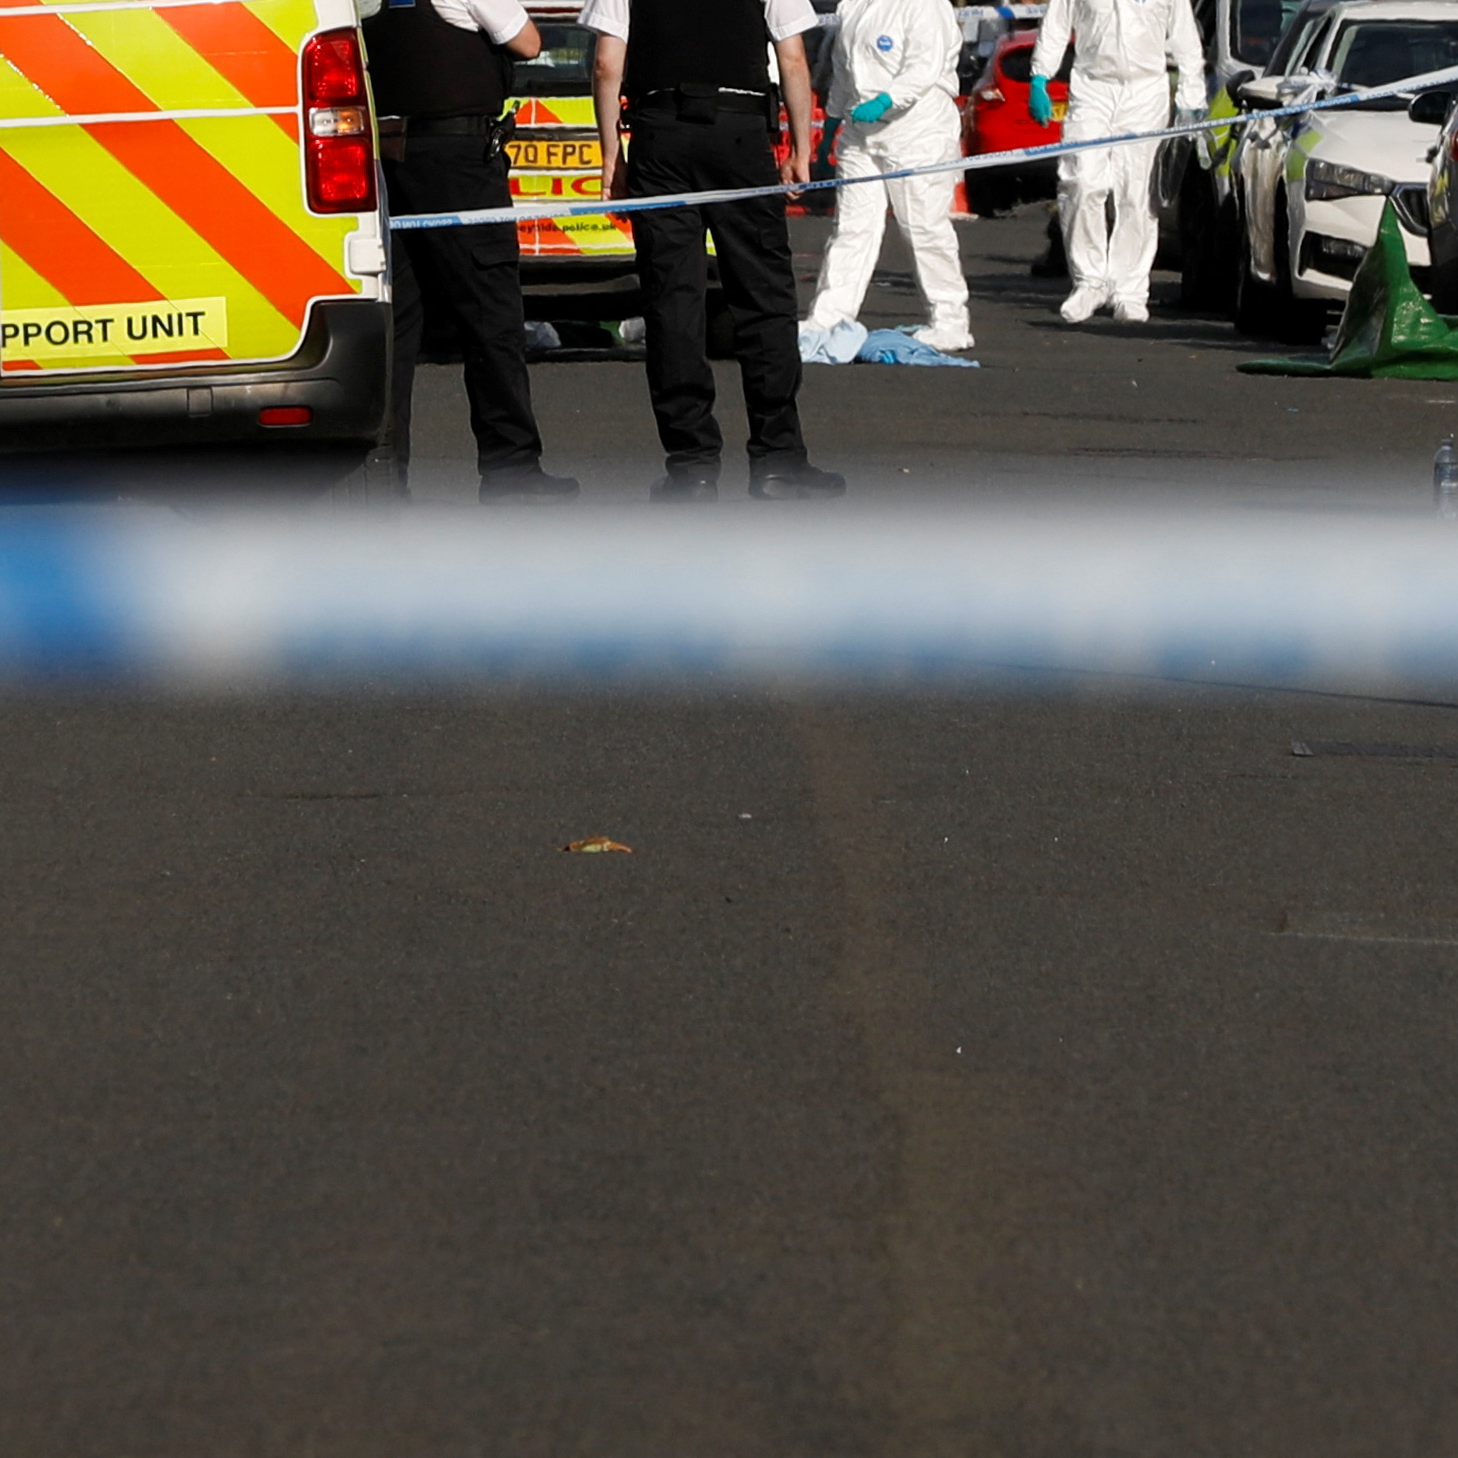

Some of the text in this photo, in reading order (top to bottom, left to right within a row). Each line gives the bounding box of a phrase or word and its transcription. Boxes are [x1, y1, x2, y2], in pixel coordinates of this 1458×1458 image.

[508, 144, 593, 165] 70 FPC
[126, 311, 206, 341] UNIT
